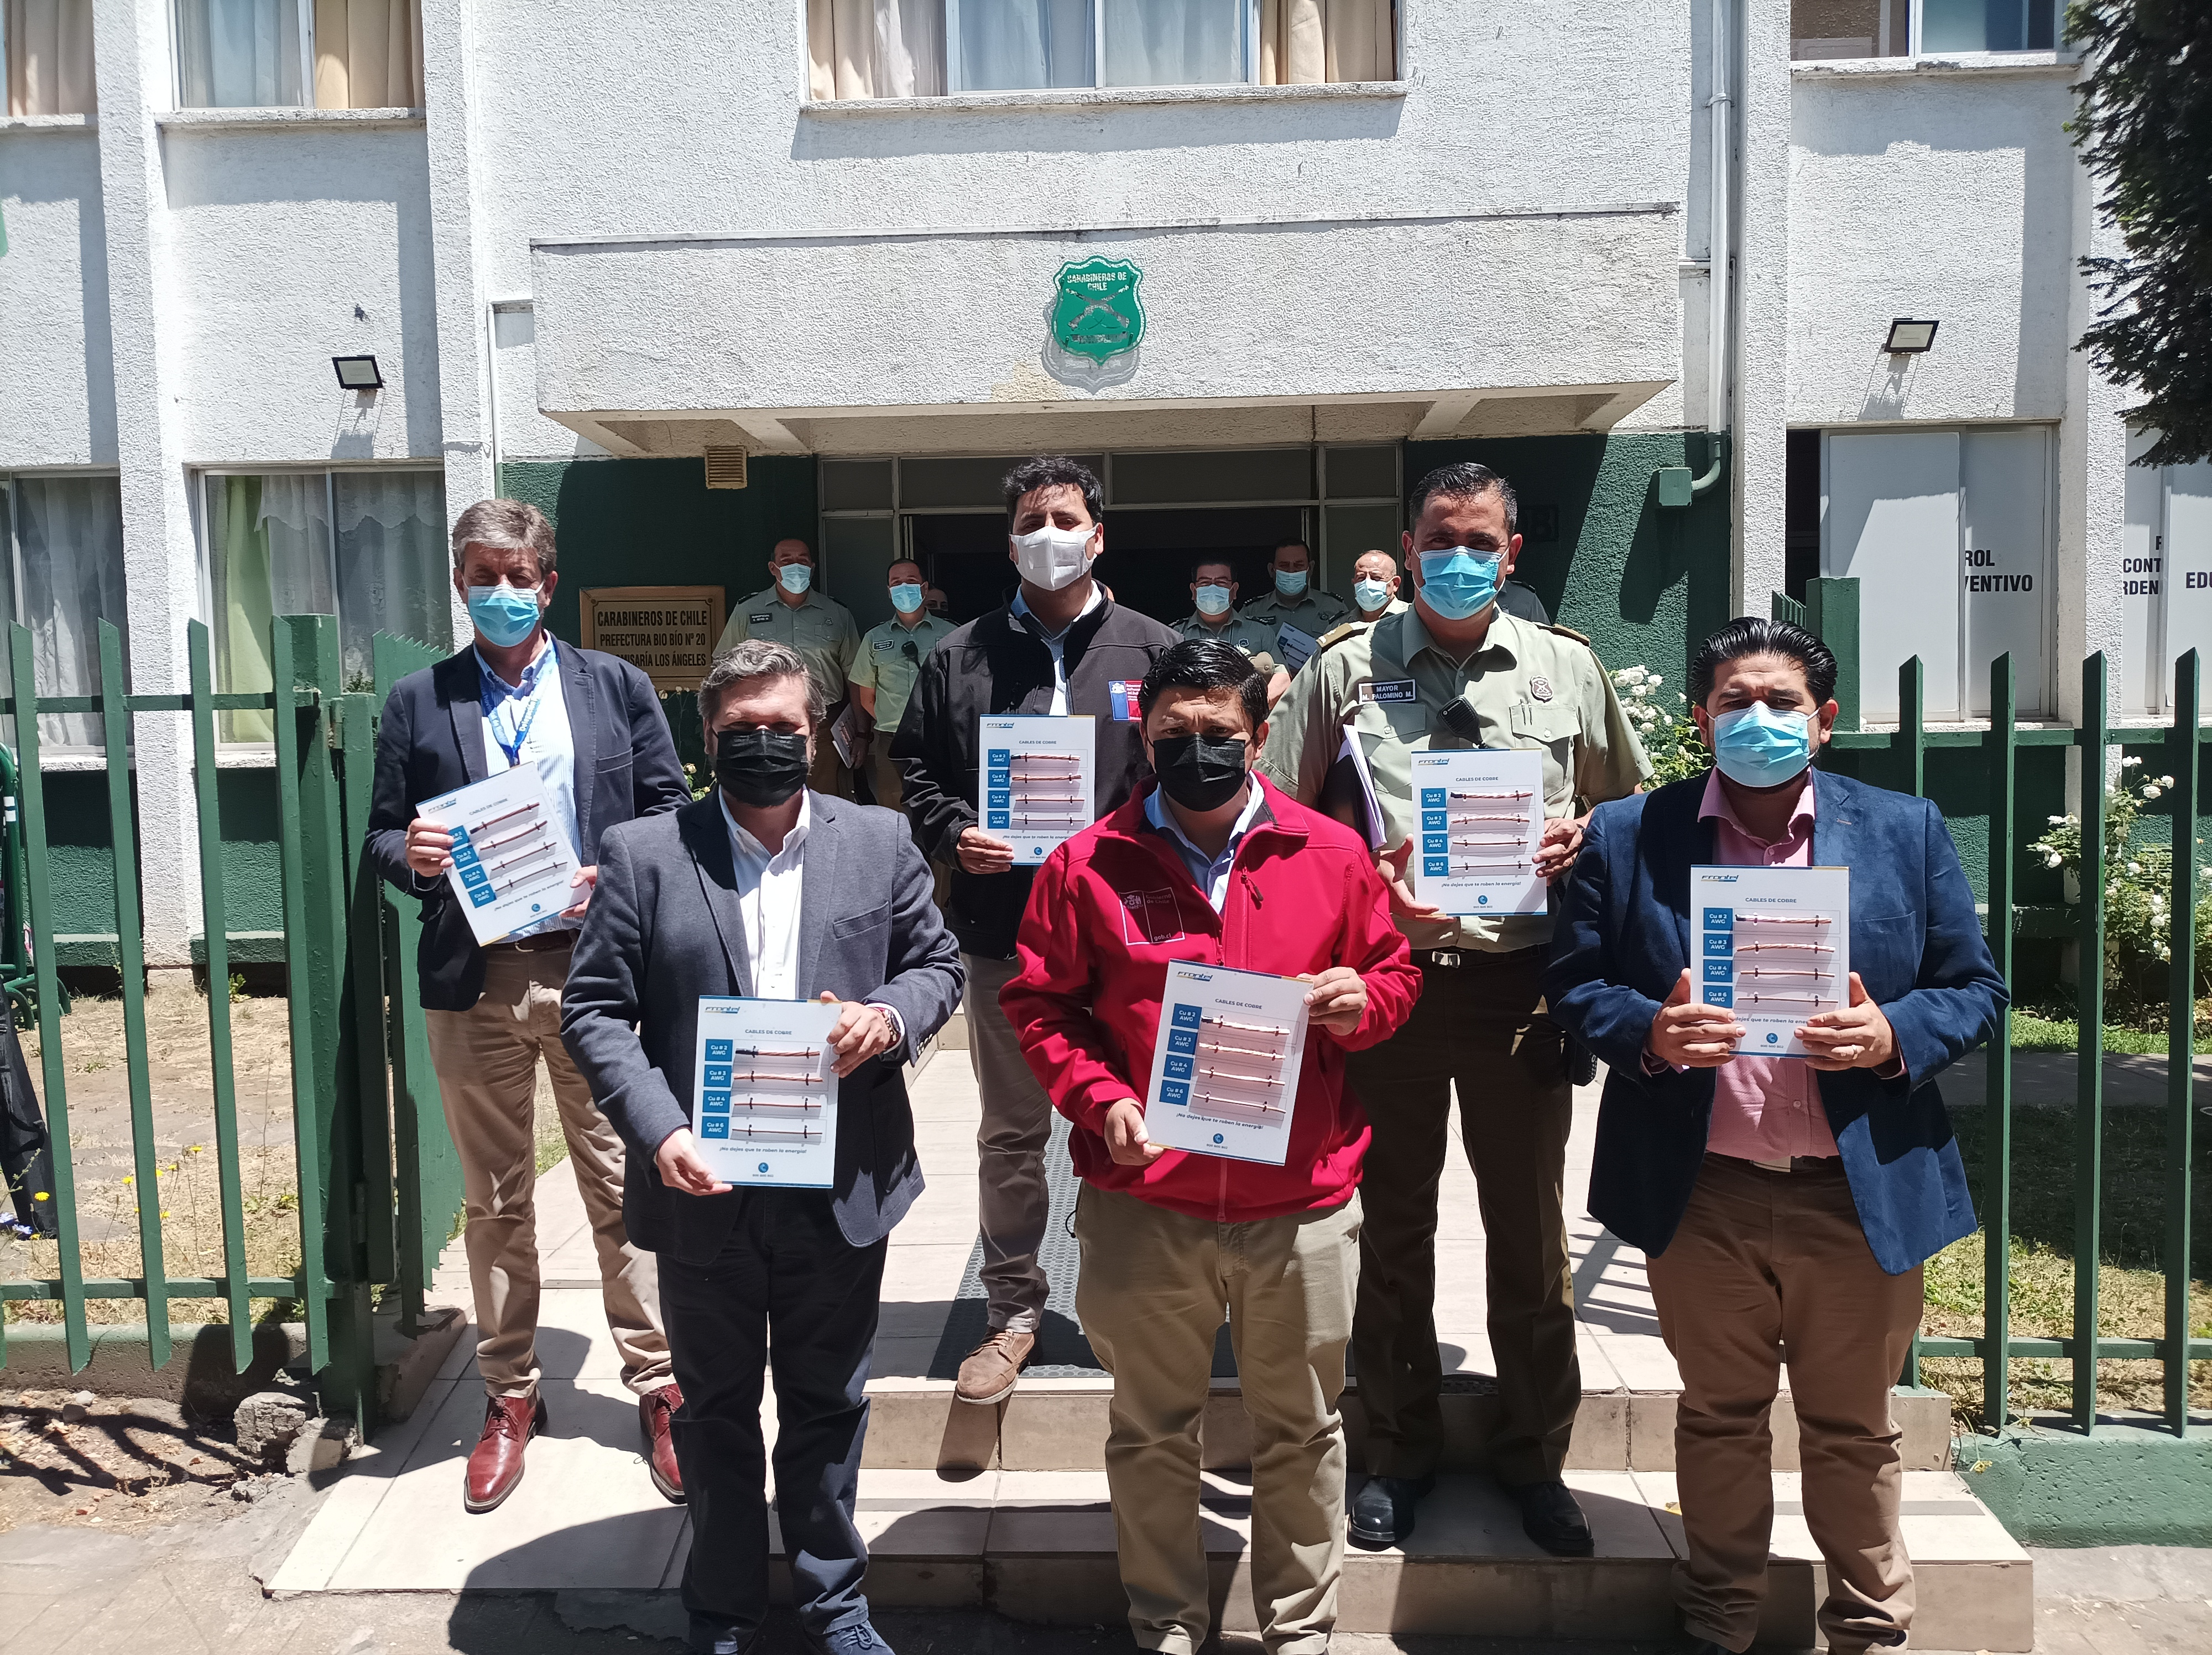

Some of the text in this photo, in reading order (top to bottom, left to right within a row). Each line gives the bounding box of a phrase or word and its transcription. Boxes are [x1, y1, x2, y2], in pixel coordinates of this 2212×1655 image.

[597, 610, 707, 626] CARABINEROS DE CHILE
[600, 633, 652, 647] PREFECTURA
[654, 633, 667, 646] BIO
[670, 629, 683, 646] BÍO
[696, 633, 706, 646] 20
[655, 654, 669, 667] LOS
[671, 650, 706, 667] ÁNGELES
[1371, 691, 1403, 700] PALOMINO
[1154, 933, 1171, 941] gob.cl
